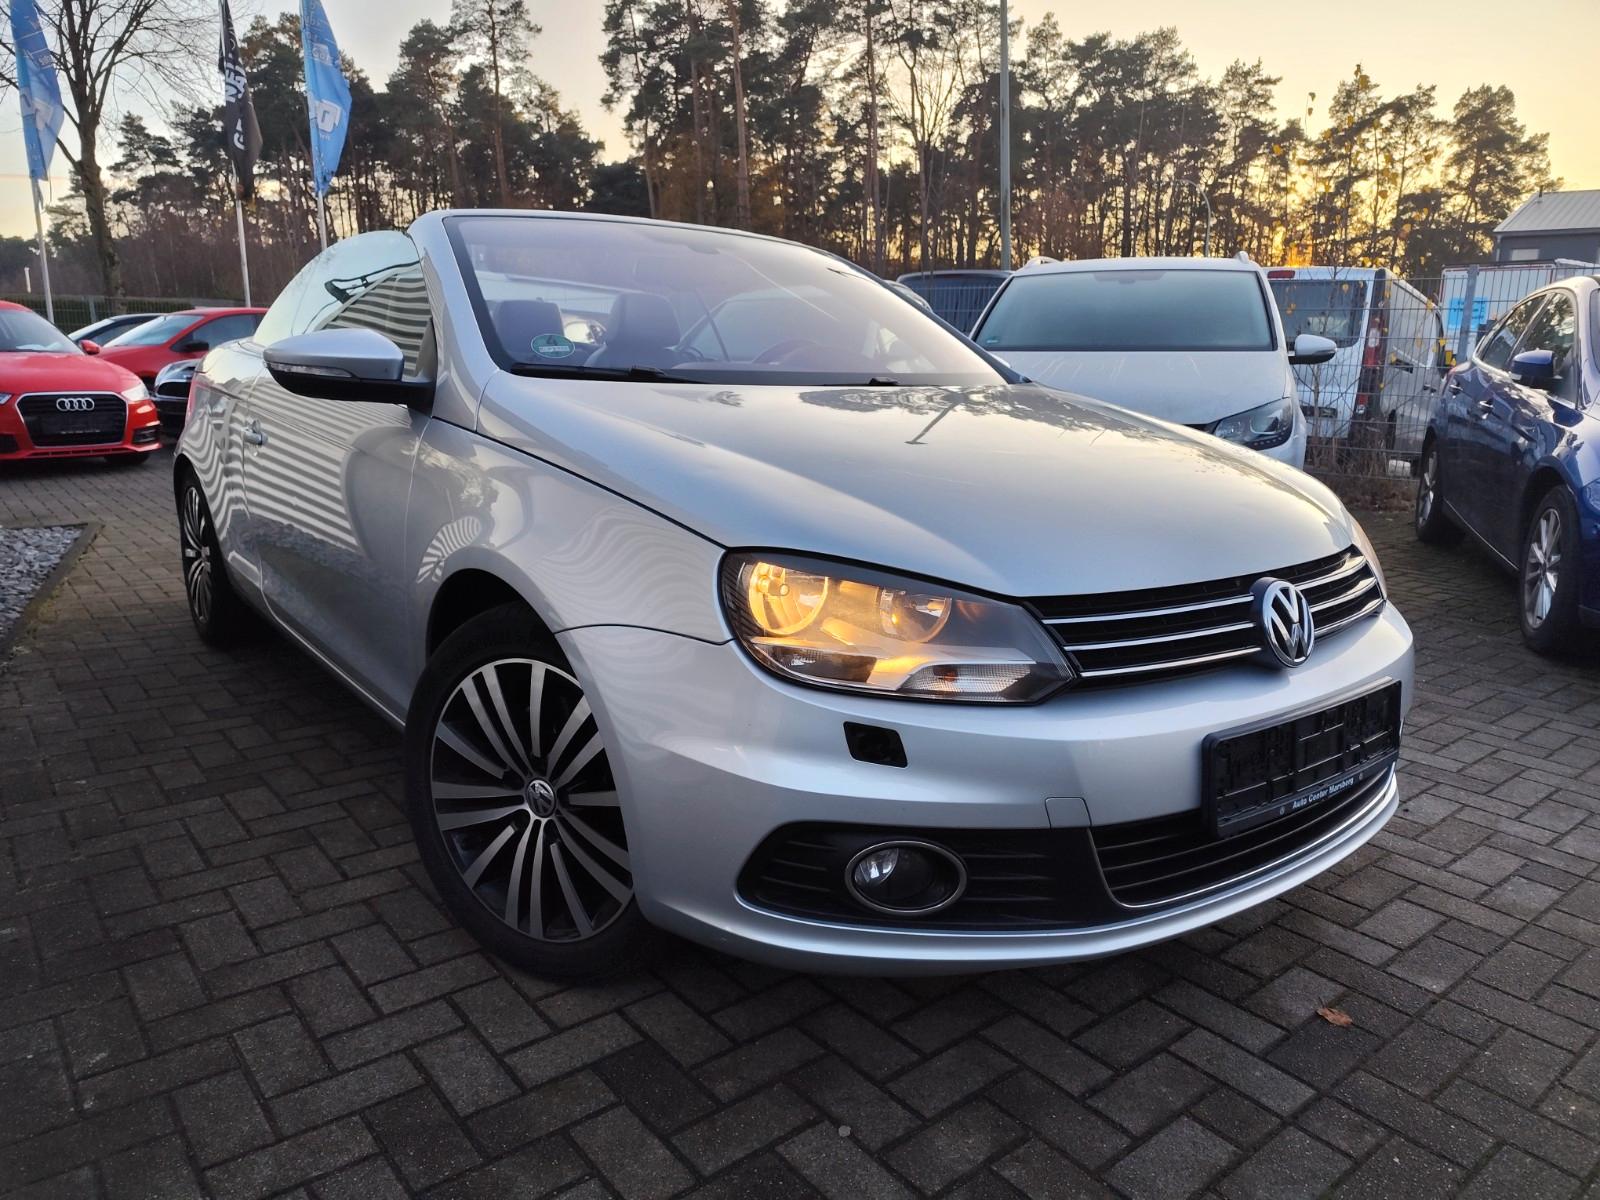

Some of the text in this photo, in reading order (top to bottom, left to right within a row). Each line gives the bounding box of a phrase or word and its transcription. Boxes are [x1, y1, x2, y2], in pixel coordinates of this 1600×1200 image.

[1263, 581, 1314, 667] VW
[1292, 798, 1308, 809] Auto
[1308, 788, 1329, 802] Center
